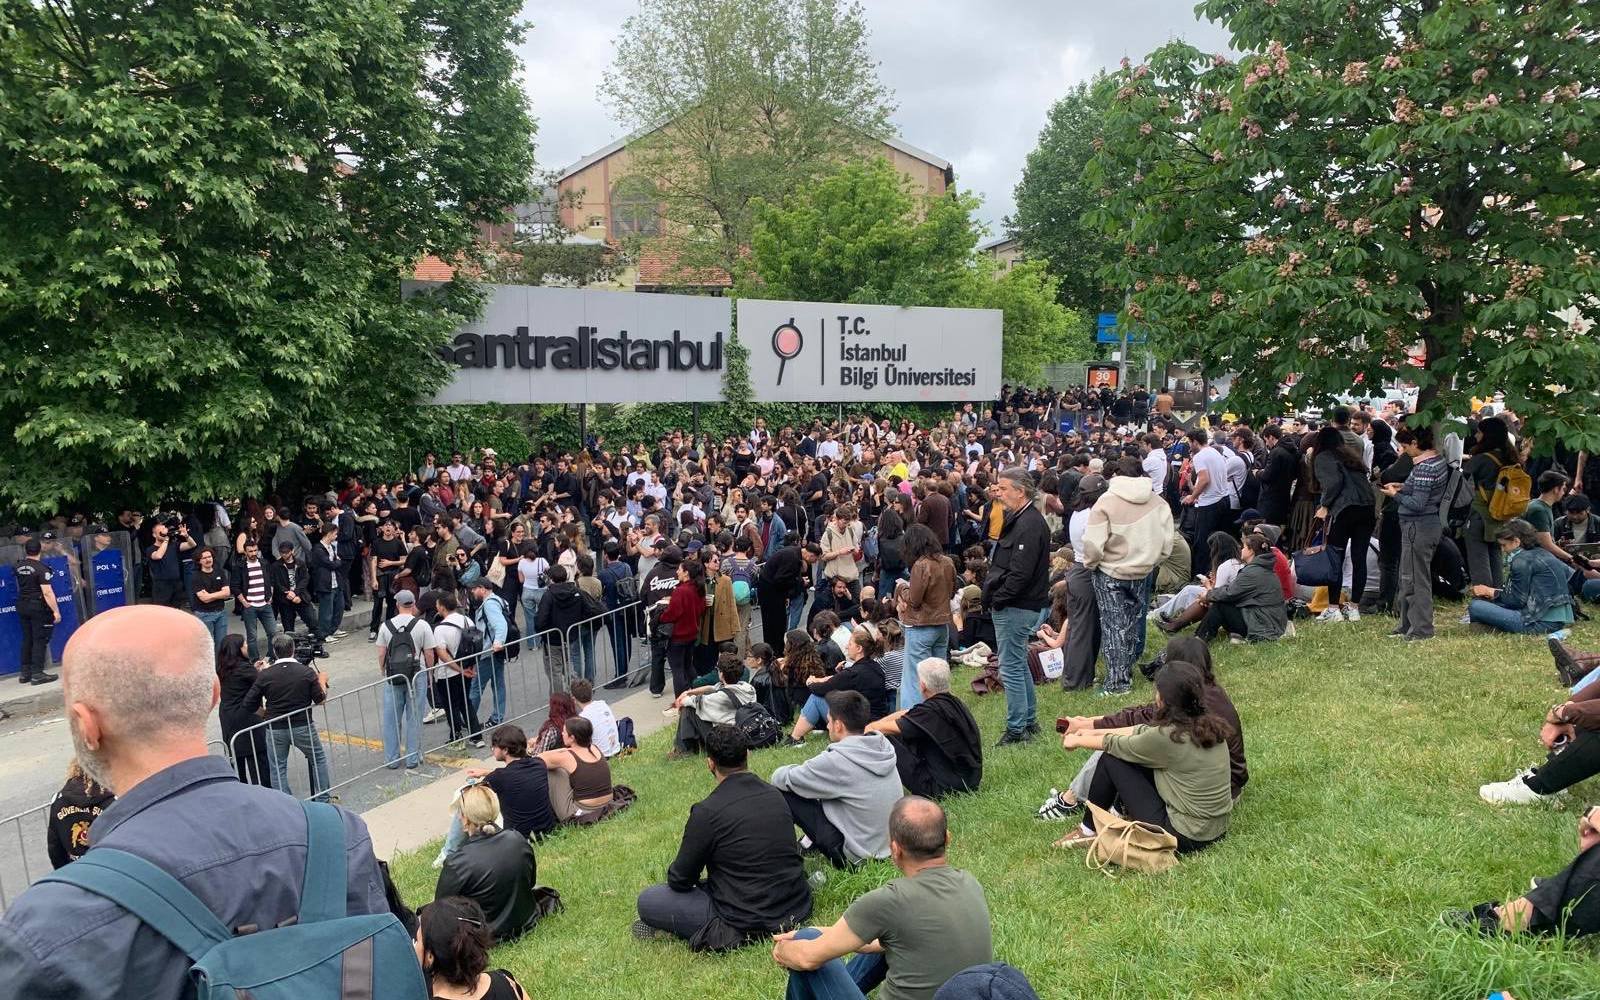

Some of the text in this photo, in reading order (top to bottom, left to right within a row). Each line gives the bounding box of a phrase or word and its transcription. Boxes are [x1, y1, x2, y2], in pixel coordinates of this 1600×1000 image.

[837, 316, 871, 335] T.C.
[840, 336, 907, 362] İstanbul
[840, 363, 976, 390] Bilgi Üniversitesi
[1095, 371, 1111, 381] 30
